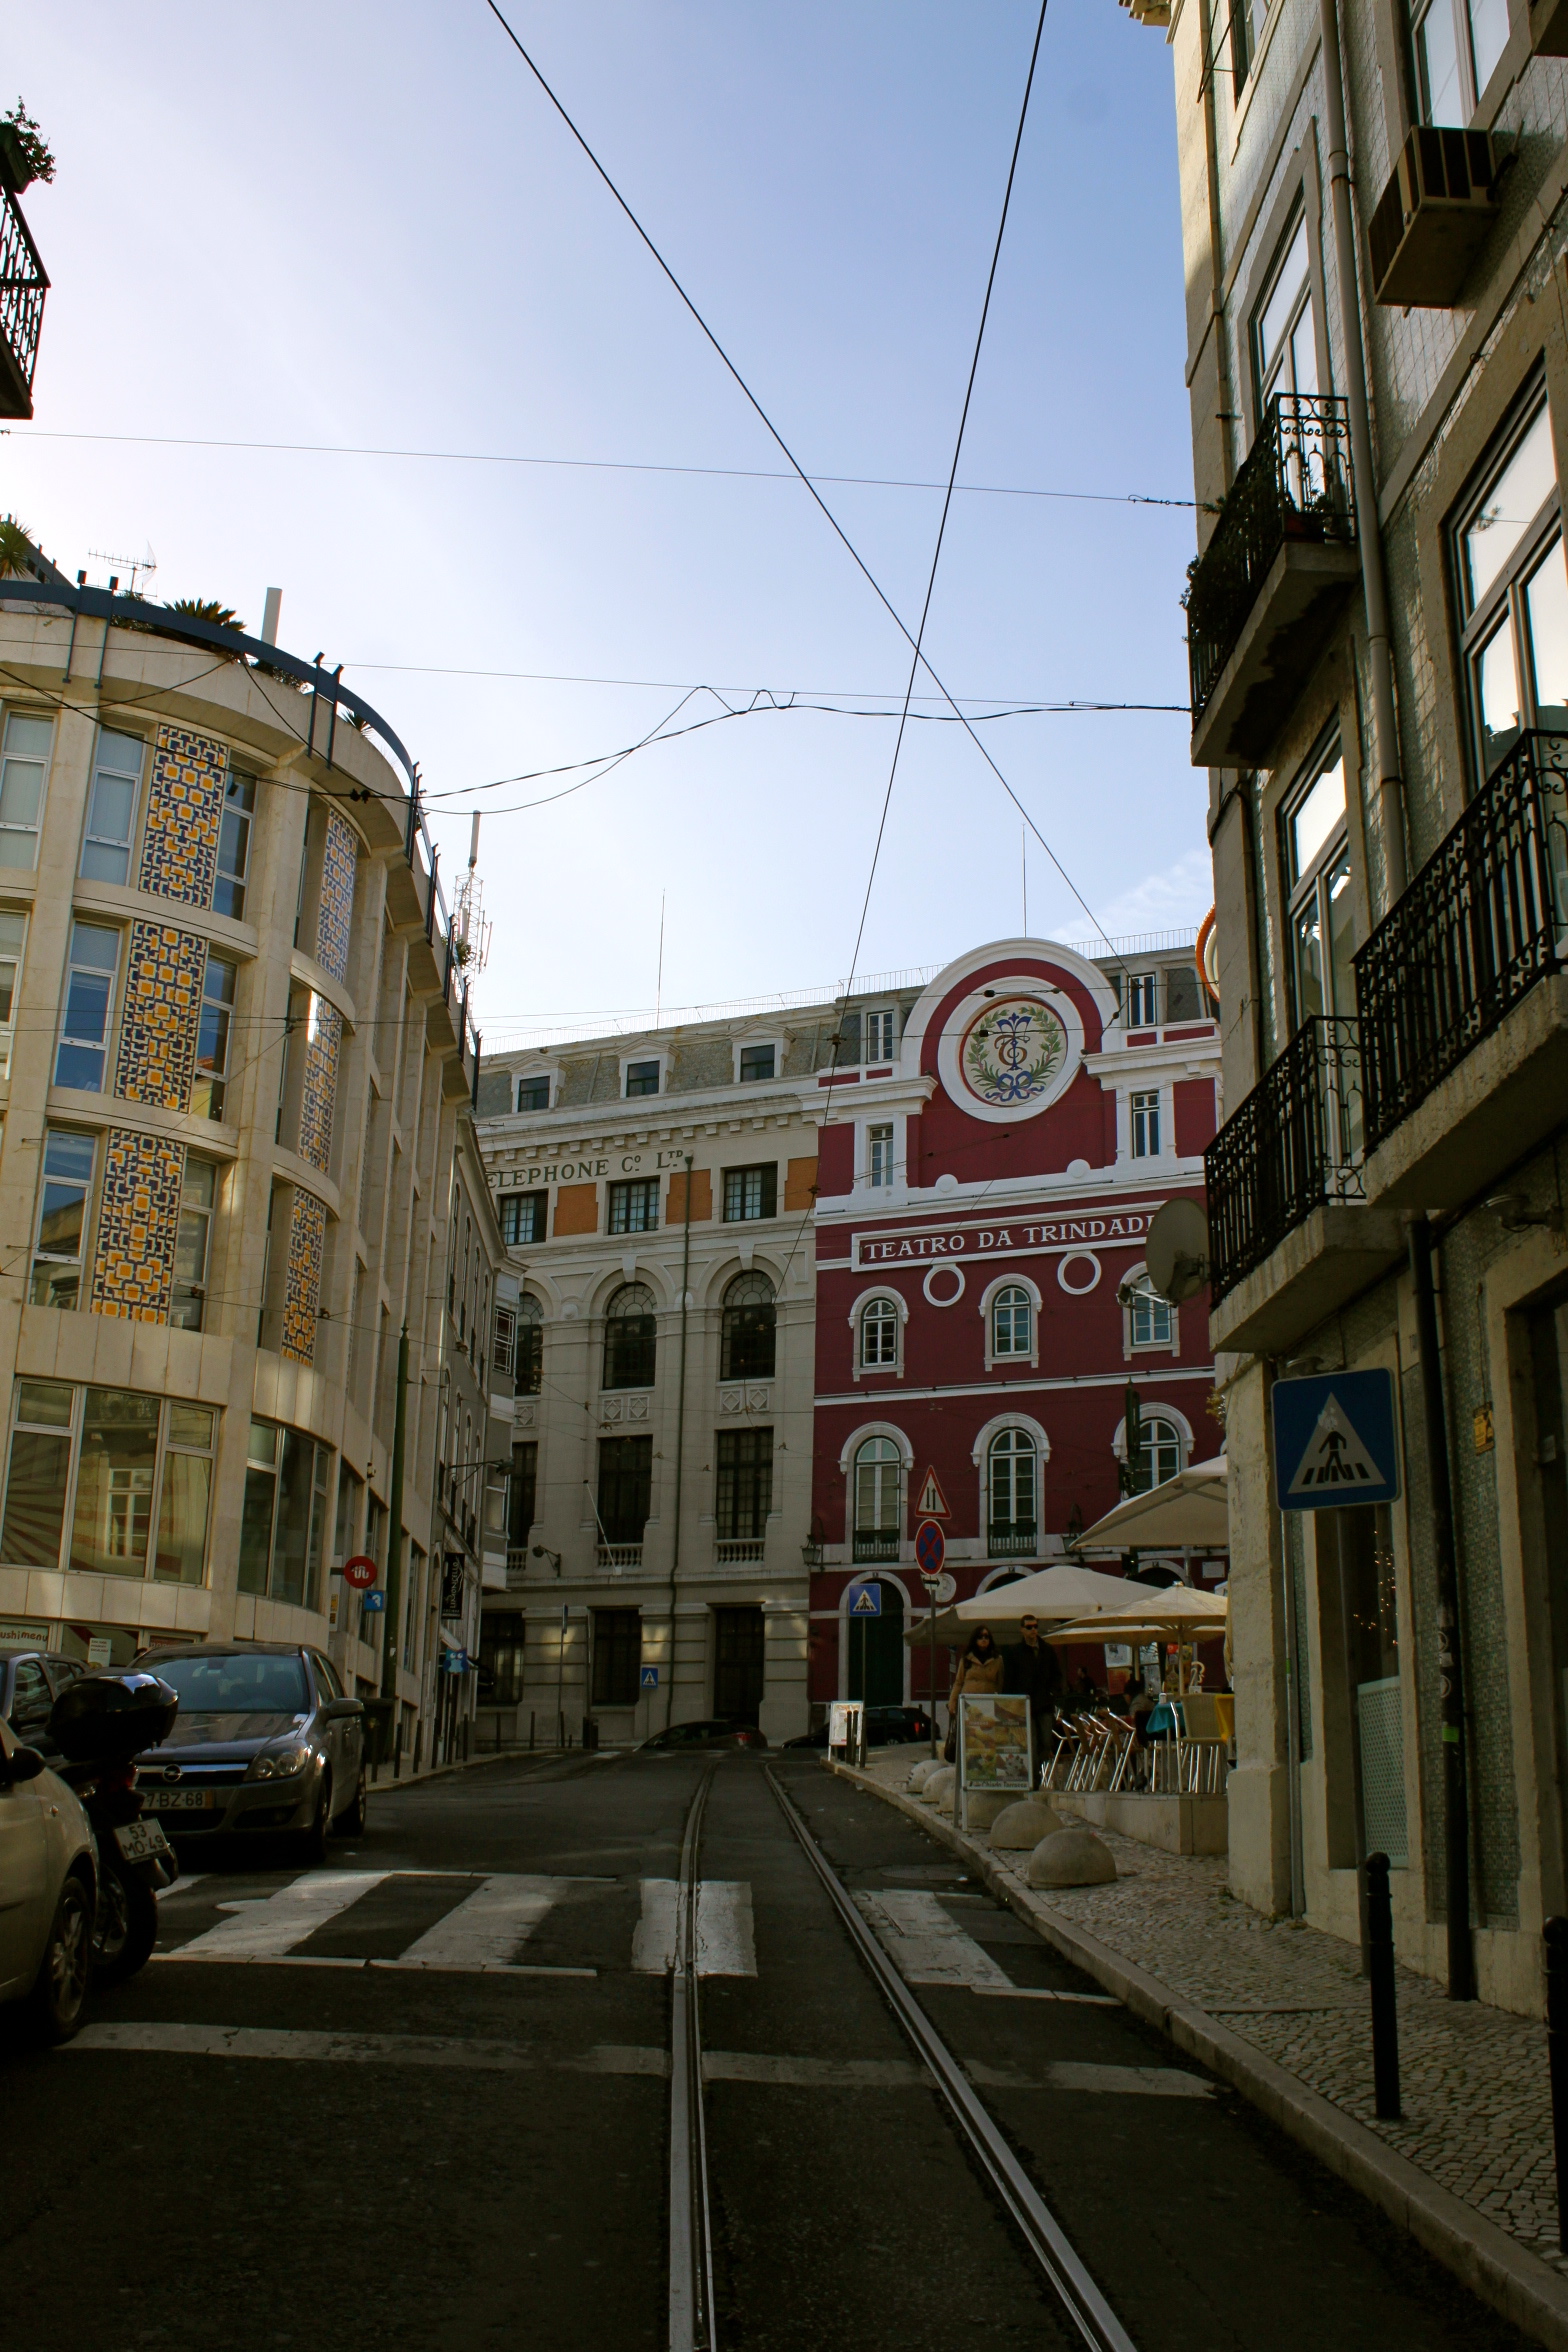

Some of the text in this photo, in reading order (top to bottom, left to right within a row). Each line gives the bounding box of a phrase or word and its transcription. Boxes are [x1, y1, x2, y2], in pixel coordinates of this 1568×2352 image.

[864, 1235, 965, 1260] TEATRO
[978, 1230, 1013, 1249] DA
[128, 1824, 147, 1840] 53
